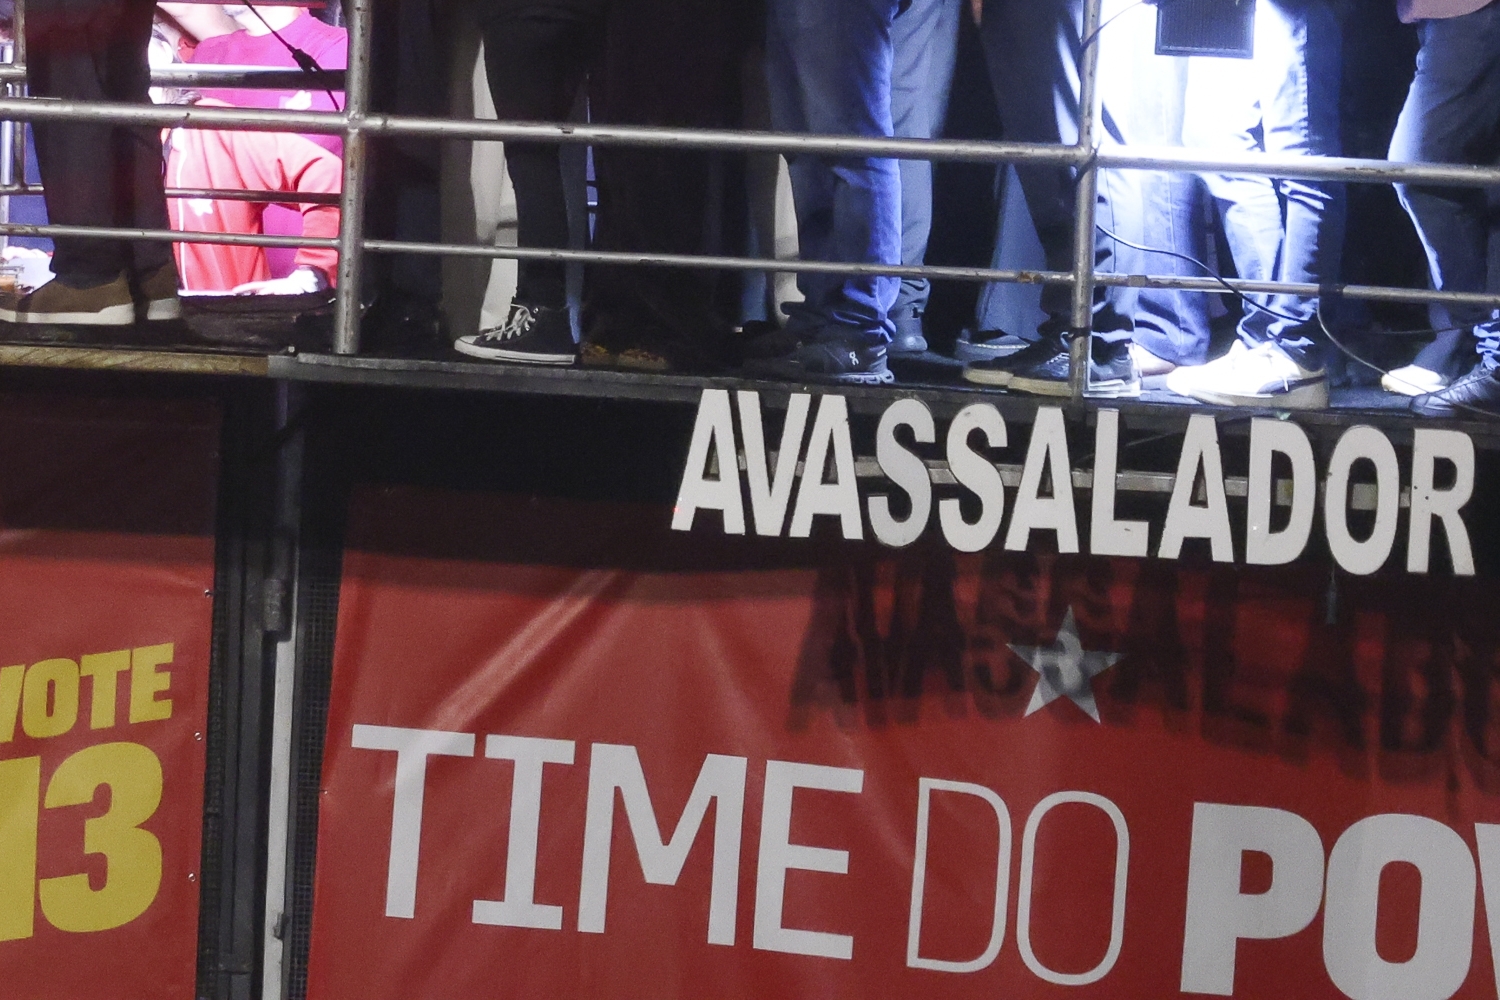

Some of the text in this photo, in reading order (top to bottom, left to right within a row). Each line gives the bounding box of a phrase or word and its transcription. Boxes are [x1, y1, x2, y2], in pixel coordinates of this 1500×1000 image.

[671, 389, 1475, 575] AVASSALADOR
[352, 724, 864, 959] TIME
[907, 777, 1129, 985] DO
